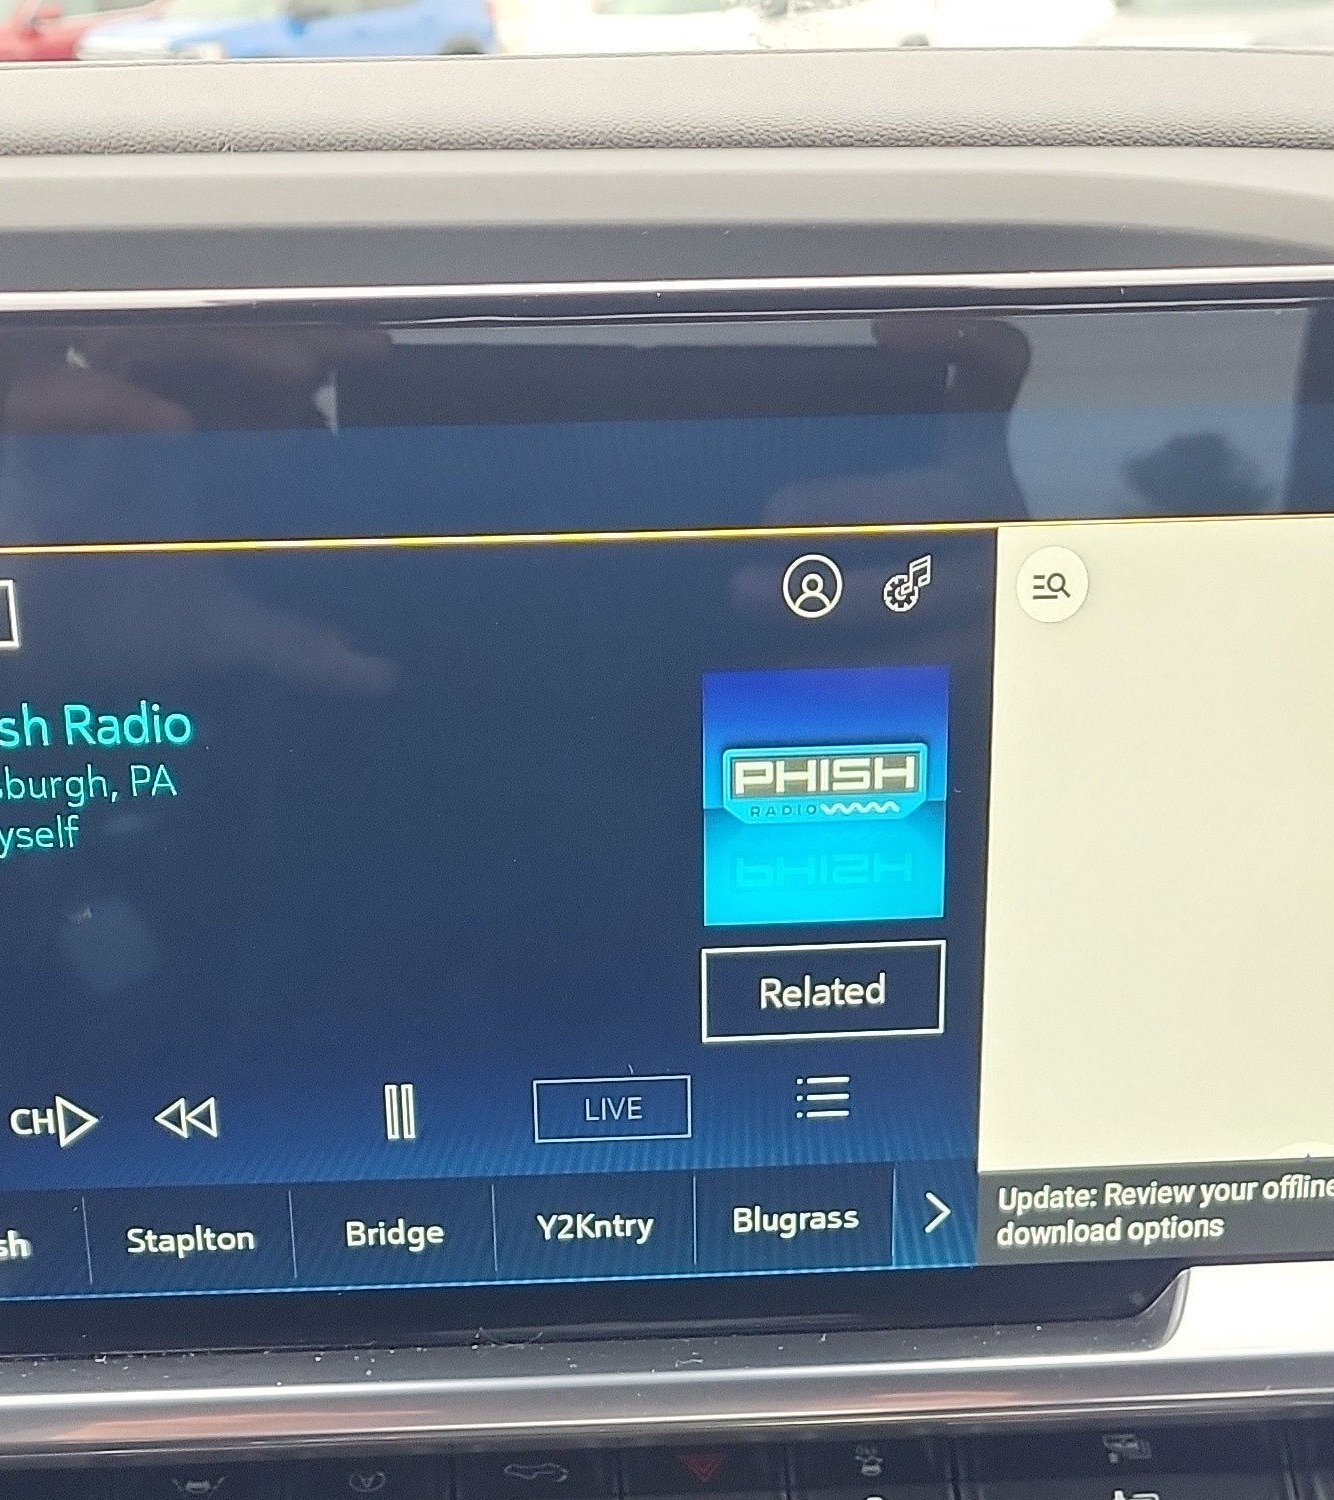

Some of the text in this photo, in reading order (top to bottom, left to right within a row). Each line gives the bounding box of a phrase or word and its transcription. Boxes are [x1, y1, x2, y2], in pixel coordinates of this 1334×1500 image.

[63, 699, 192, 747] Radio
[130, 763, 178, 797] PA
[734, 755, 916, 795] PHISH
[750, 804, 816, 817] RADIO
[760, 972, 886, 1010] Related
[10, 1108, 55, 1135] CH
[585, 1096, 643, 1121] LIVE
[998, 1184, 1098, 1217] Update:
[1104, 1180, 1197, 1208] Review
[1199, 1181, 1259, 1209] your
[346, 1218, 445, 1253] Bridge
[536, 1213, 655, 1245] Y2Kntry
[733, 1205, 860, 1239] Blugrass
[996, 1215, 1225, 1247] download options
[127, 1224, 256, 1259] Staplton
